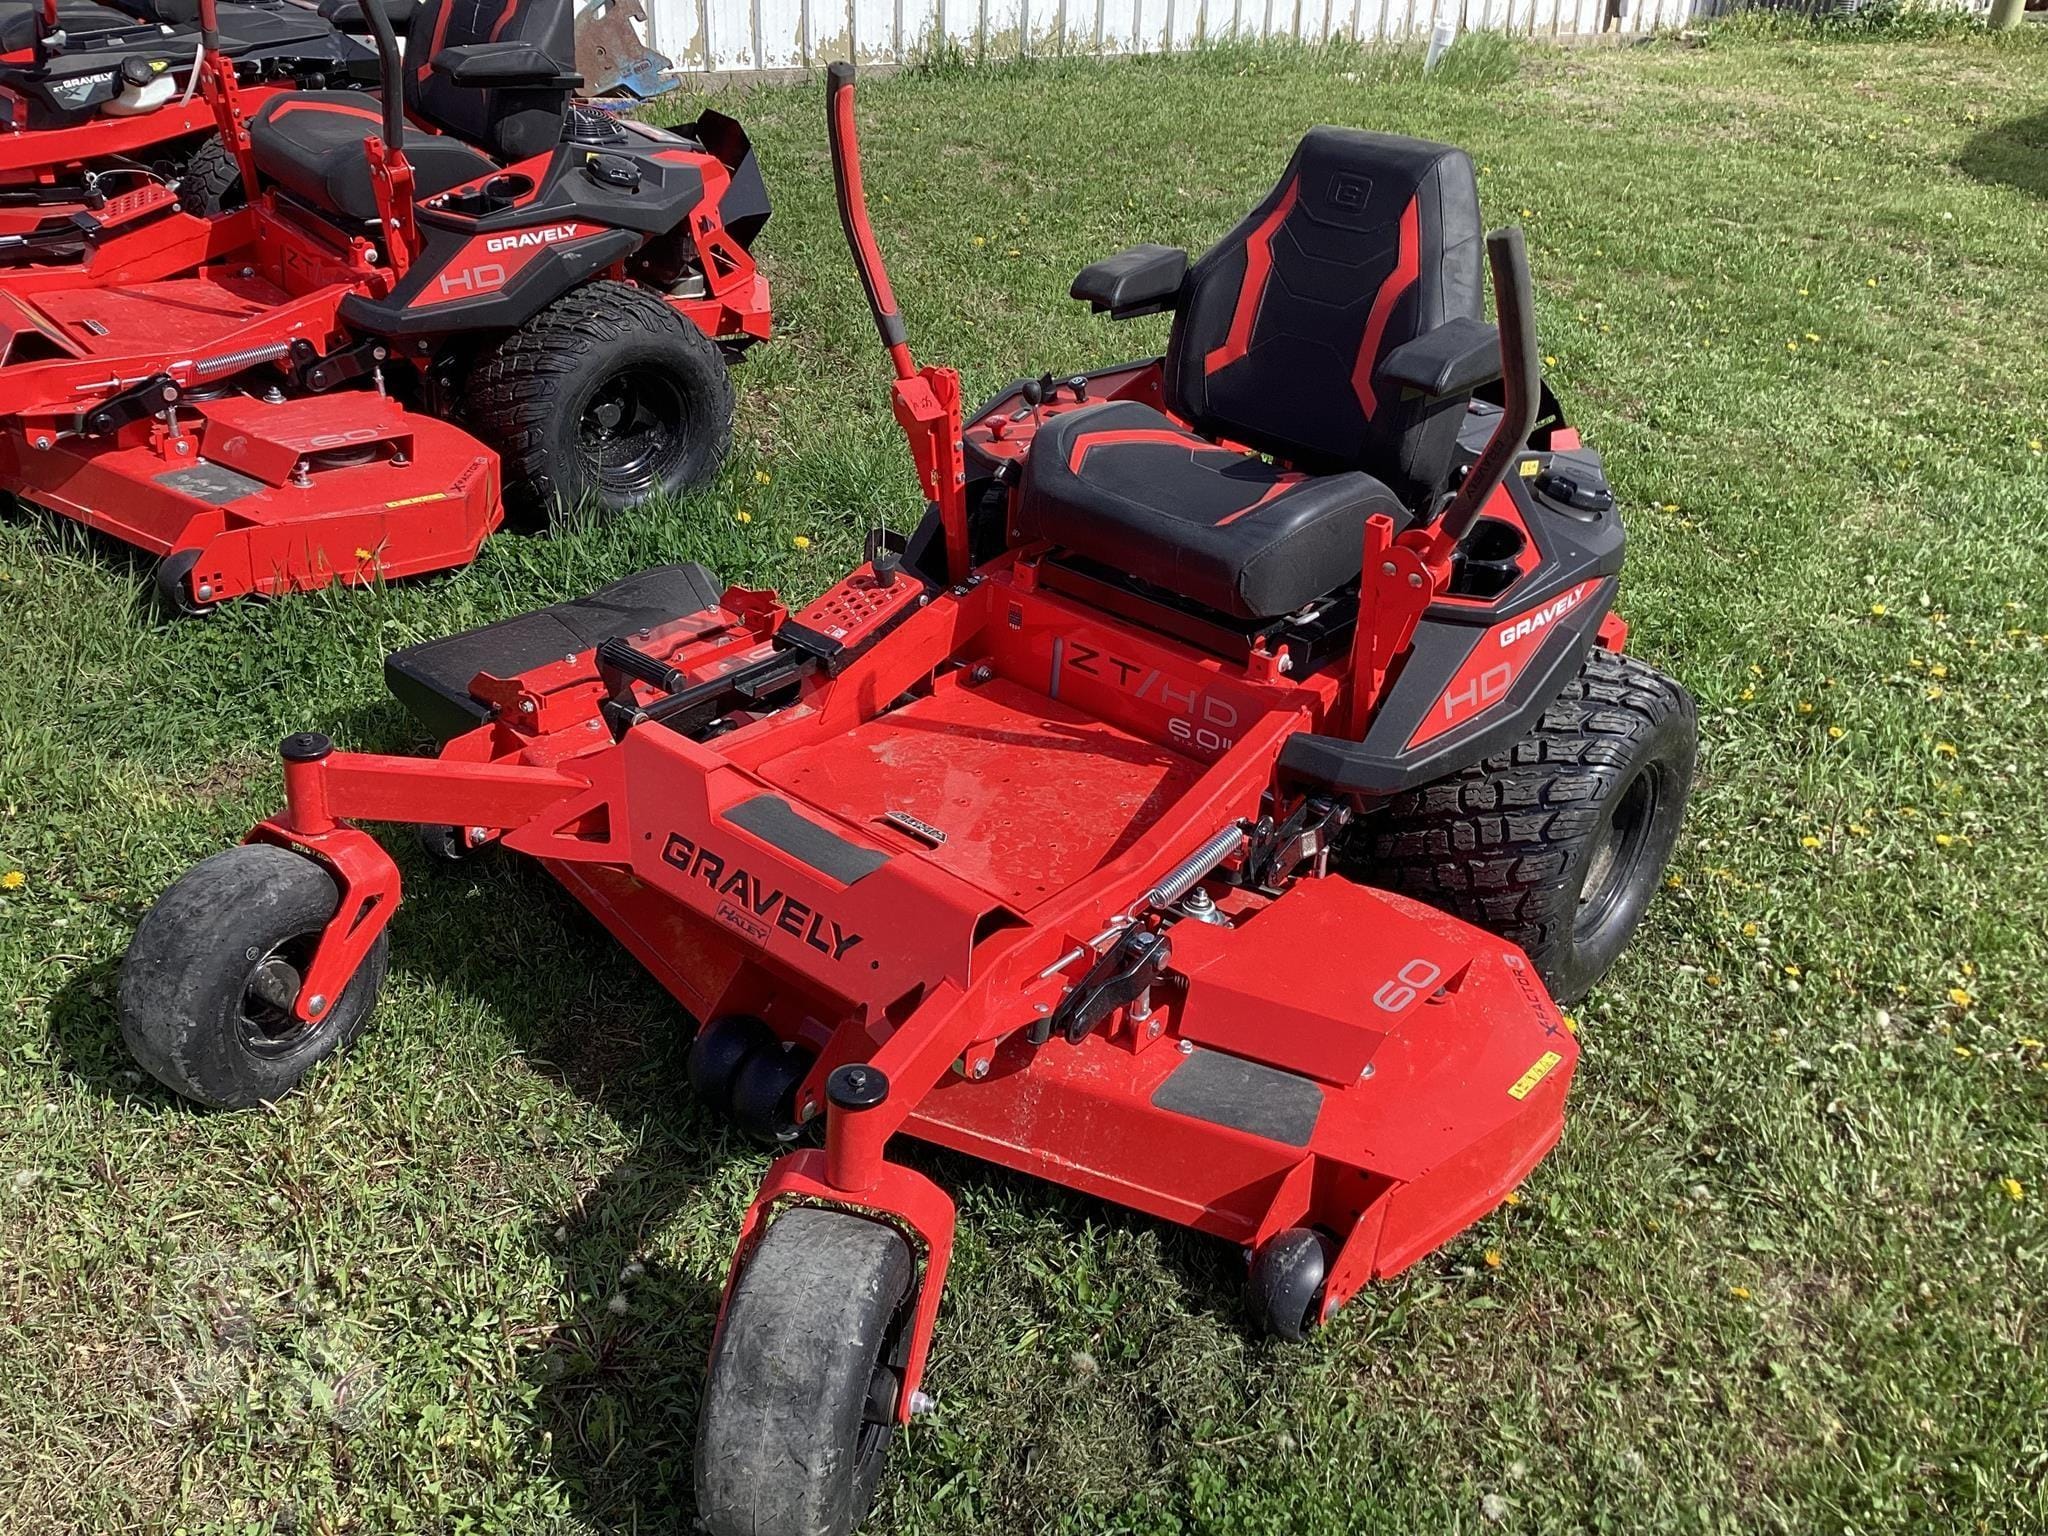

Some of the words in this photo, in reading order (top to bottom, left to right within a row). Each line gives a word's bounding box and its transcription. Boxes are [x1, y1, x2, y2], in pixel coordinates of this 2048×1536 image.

[62, 72, 113, 88] GRAVELY
[487, 224, 577, 252] GRAVELY
[439, 263, 506, 294] HD
[310, 428, 378, 447] 60
[1500, 583, 1586, 648] GRAVELY
[1068, 641, 1238, 728] ZT/HD
[1444, 661, 1512, 720] HD
[660, 831, 864, 962] GRAVELY
[718, 905, 768, 939] HALEY
[1372, 959, 1441, 1013] 60
